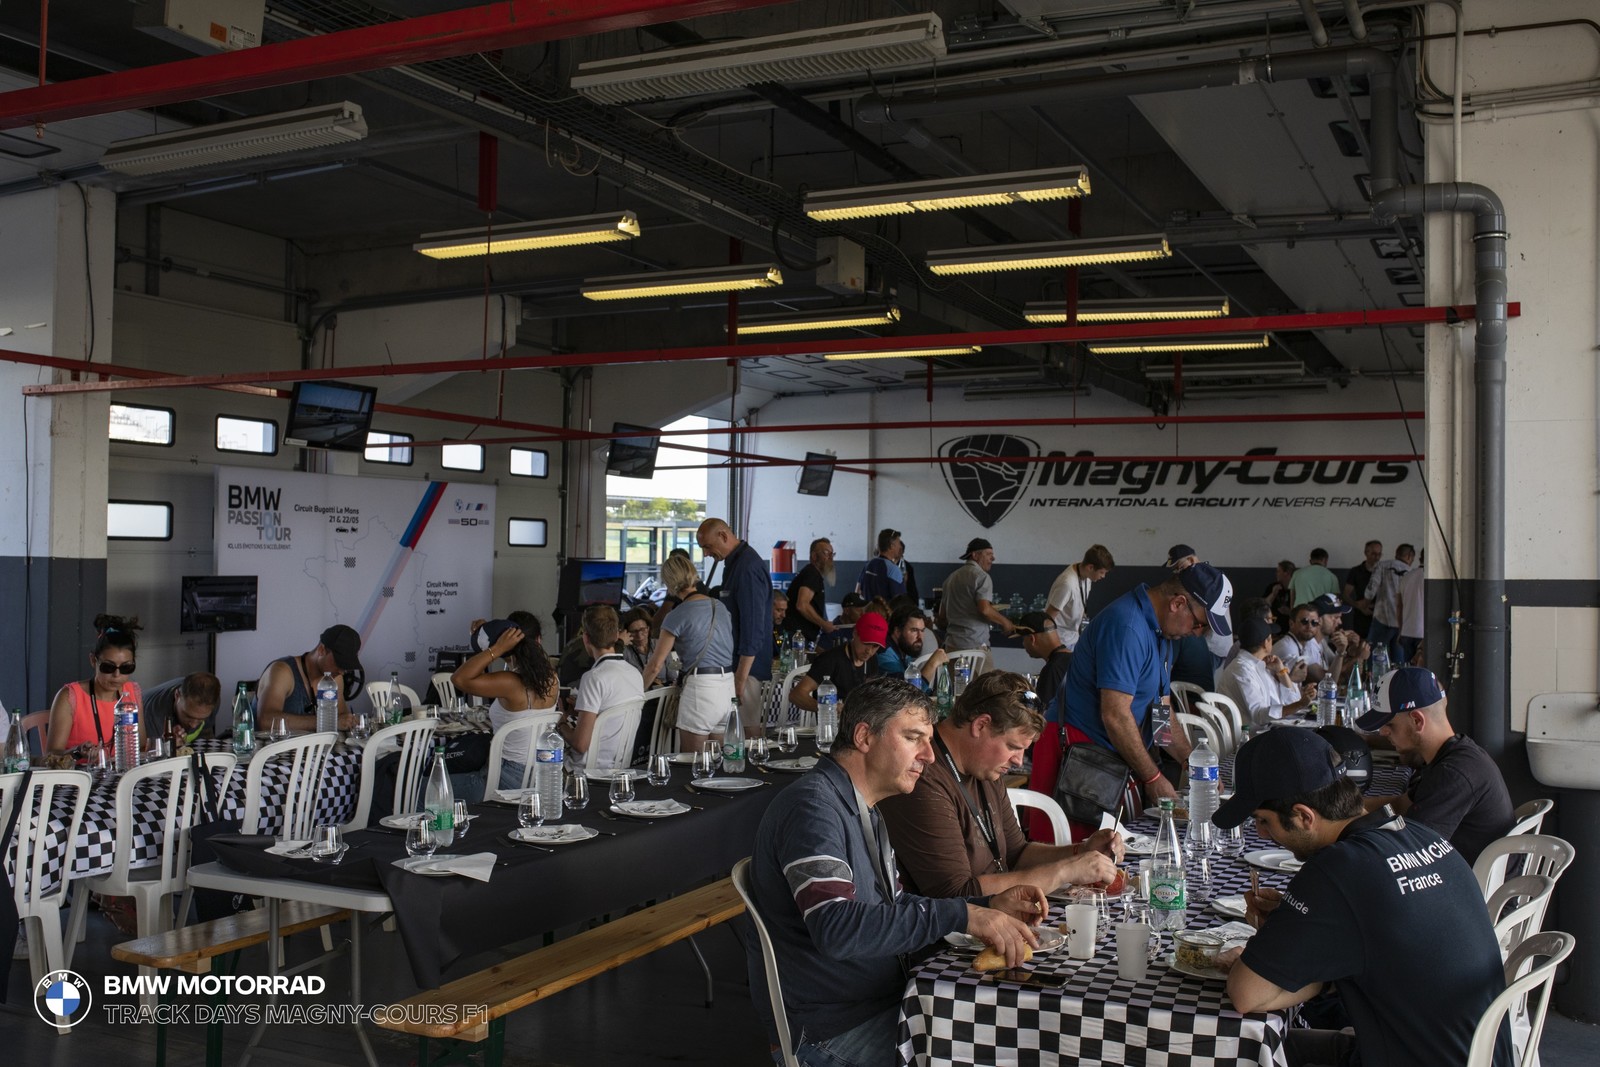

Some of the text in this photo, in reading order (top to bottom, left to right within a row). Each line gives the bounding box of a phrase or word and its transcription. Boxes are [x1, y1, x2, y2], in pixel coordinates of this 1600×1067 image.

[1037, 447, 1411, 494] Magny-Cours
[228, 485, 281, 511] BMW
[1029, 498, 1169, 507] INTERNATIONAL
[1175, 497, 1249, 507] CIRCUIT
[1262, 497, 1325, 507] NEVERS
[1330, 497, 1396, 507] FRANCE
[294, 504, 313, 513] Circuit
[314, 506, 336, 515] Bugatti
[228, 511, 281, 526] PASSION
[461, 517, 478, 526] 50
[257, 526, 291, 541] TOUR
[426, 590, 457, 598] Magny-Cours
[1386, 838, 1454, 873] BMW M Club
[1396, 872, 1443, 895] France
